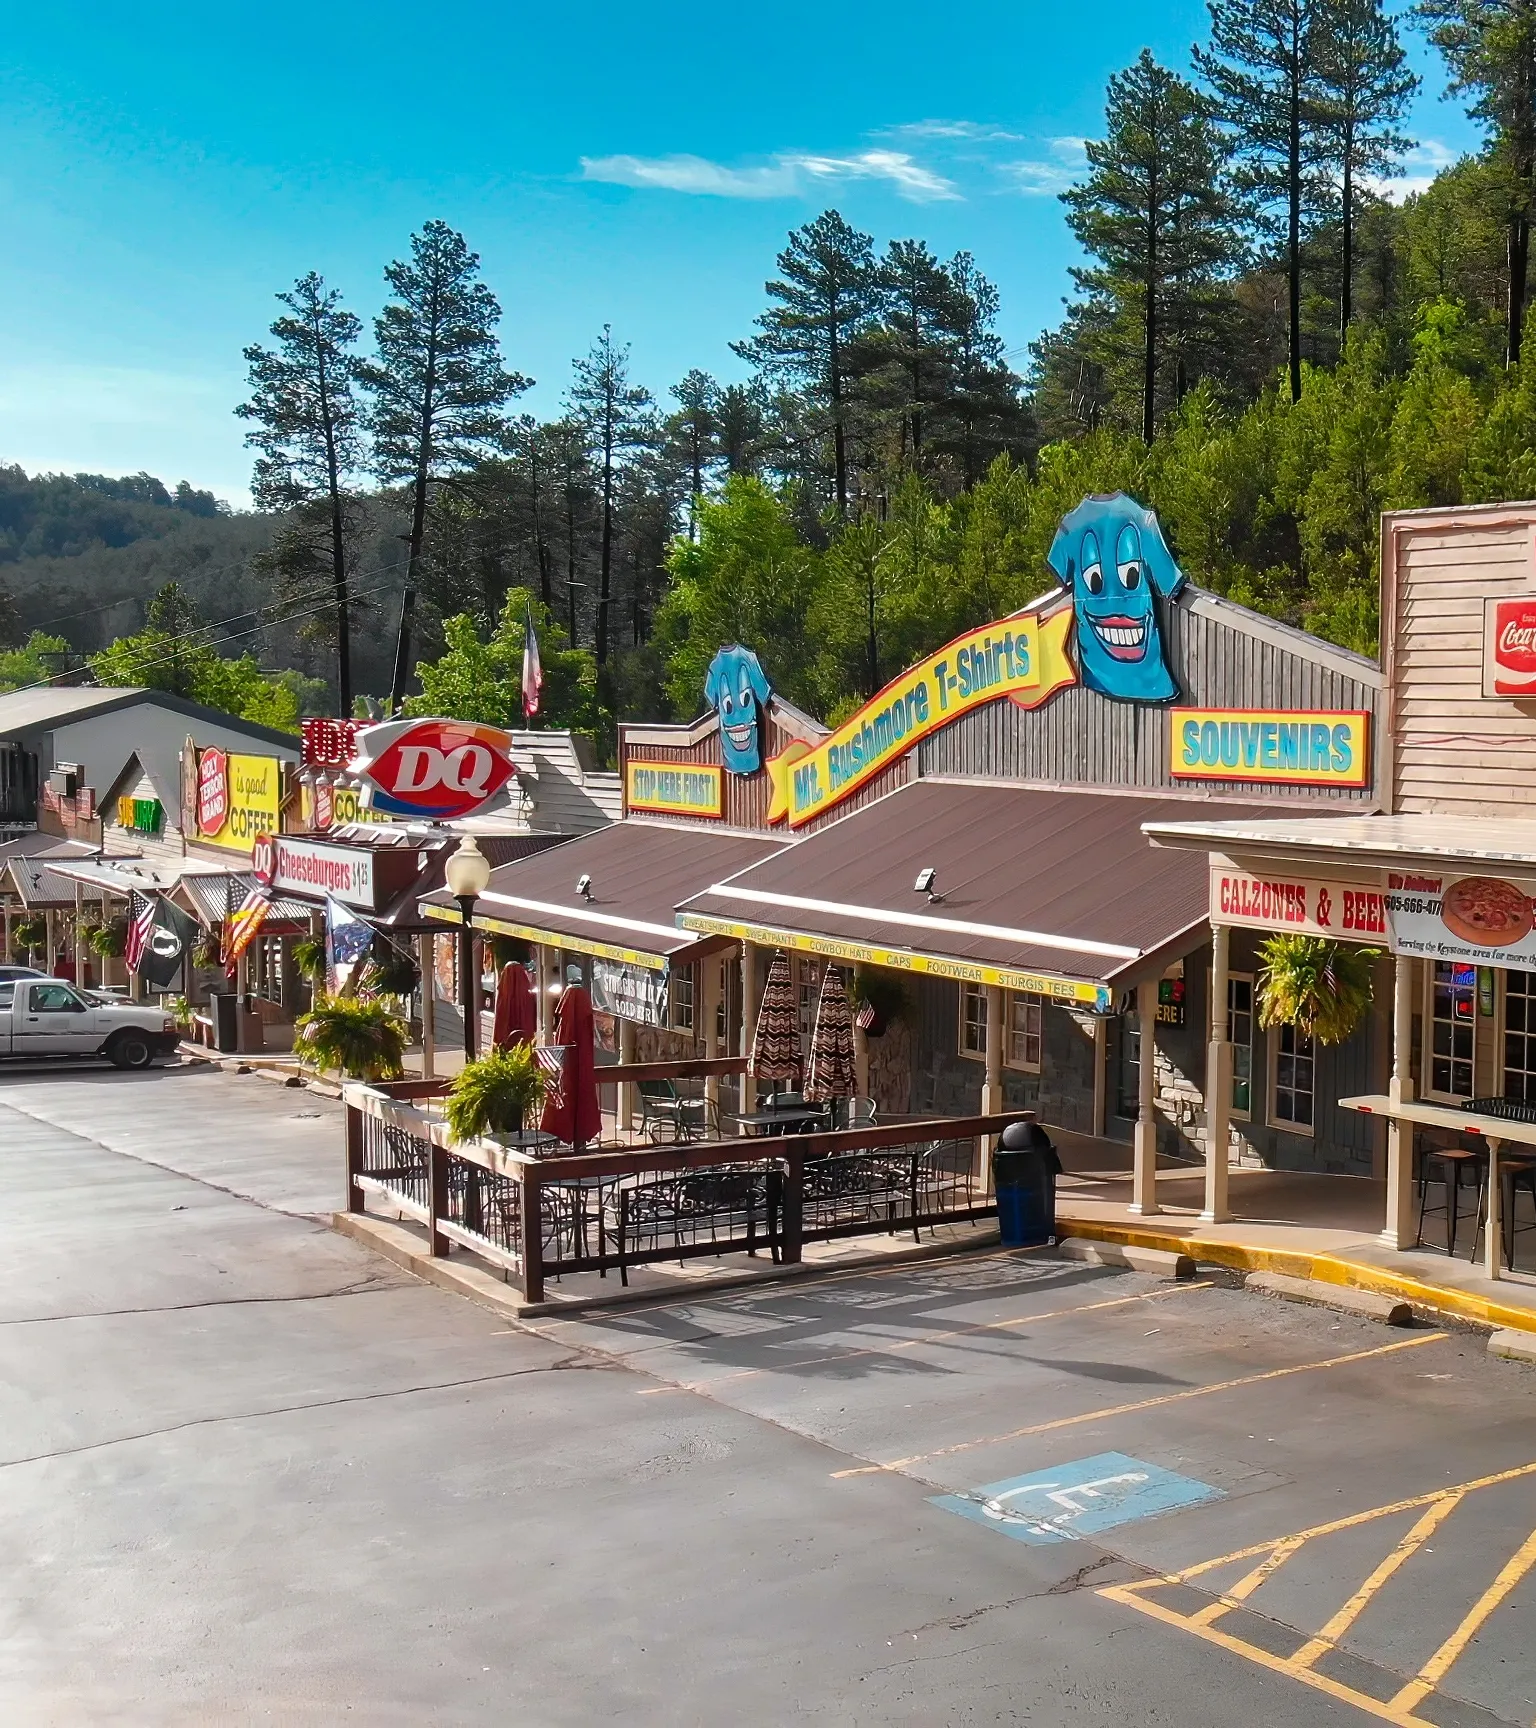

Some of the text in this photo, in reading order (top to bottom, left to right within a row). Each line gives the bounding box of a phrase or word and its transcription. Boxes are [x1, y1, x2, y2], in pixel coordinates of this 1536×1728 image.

[793, 631, 1030, 813] Mt. Rushmore T-Shirts
[1182, 720, 1352, 773] SOUVENIRS
[236, 767, 268, 804] is good
[391, 744, 493, 799] DQ
[634, 769, 656, 801] STOP
[657, 771, 682, 804] HERE
[230, 807, 274, 840] COFFEE
[254, 843, 272, 879] DQ
[279, 846, 351, 892] Cheeseburgers
[1220, 877, 1306, 924] CALZONES
[1317, 887, 1332, 927] &
[684, 916, 1076, 997] SWEATSHIRTS SWEATPANTS COWBOY HATS CAPS FOOTWEAR STURGIS TEES
[1397, 937, 1425, 952] Serving
[1437, 942, 1472, 956] Keystone
[1472, 948, 1491, 959] area
[1491, 949, 1505, 960] for
[1506, 953, 1528, 963] more
[603, 973, 636, 998] STURGIS
[615, 999, 636, 1018] SOLD
